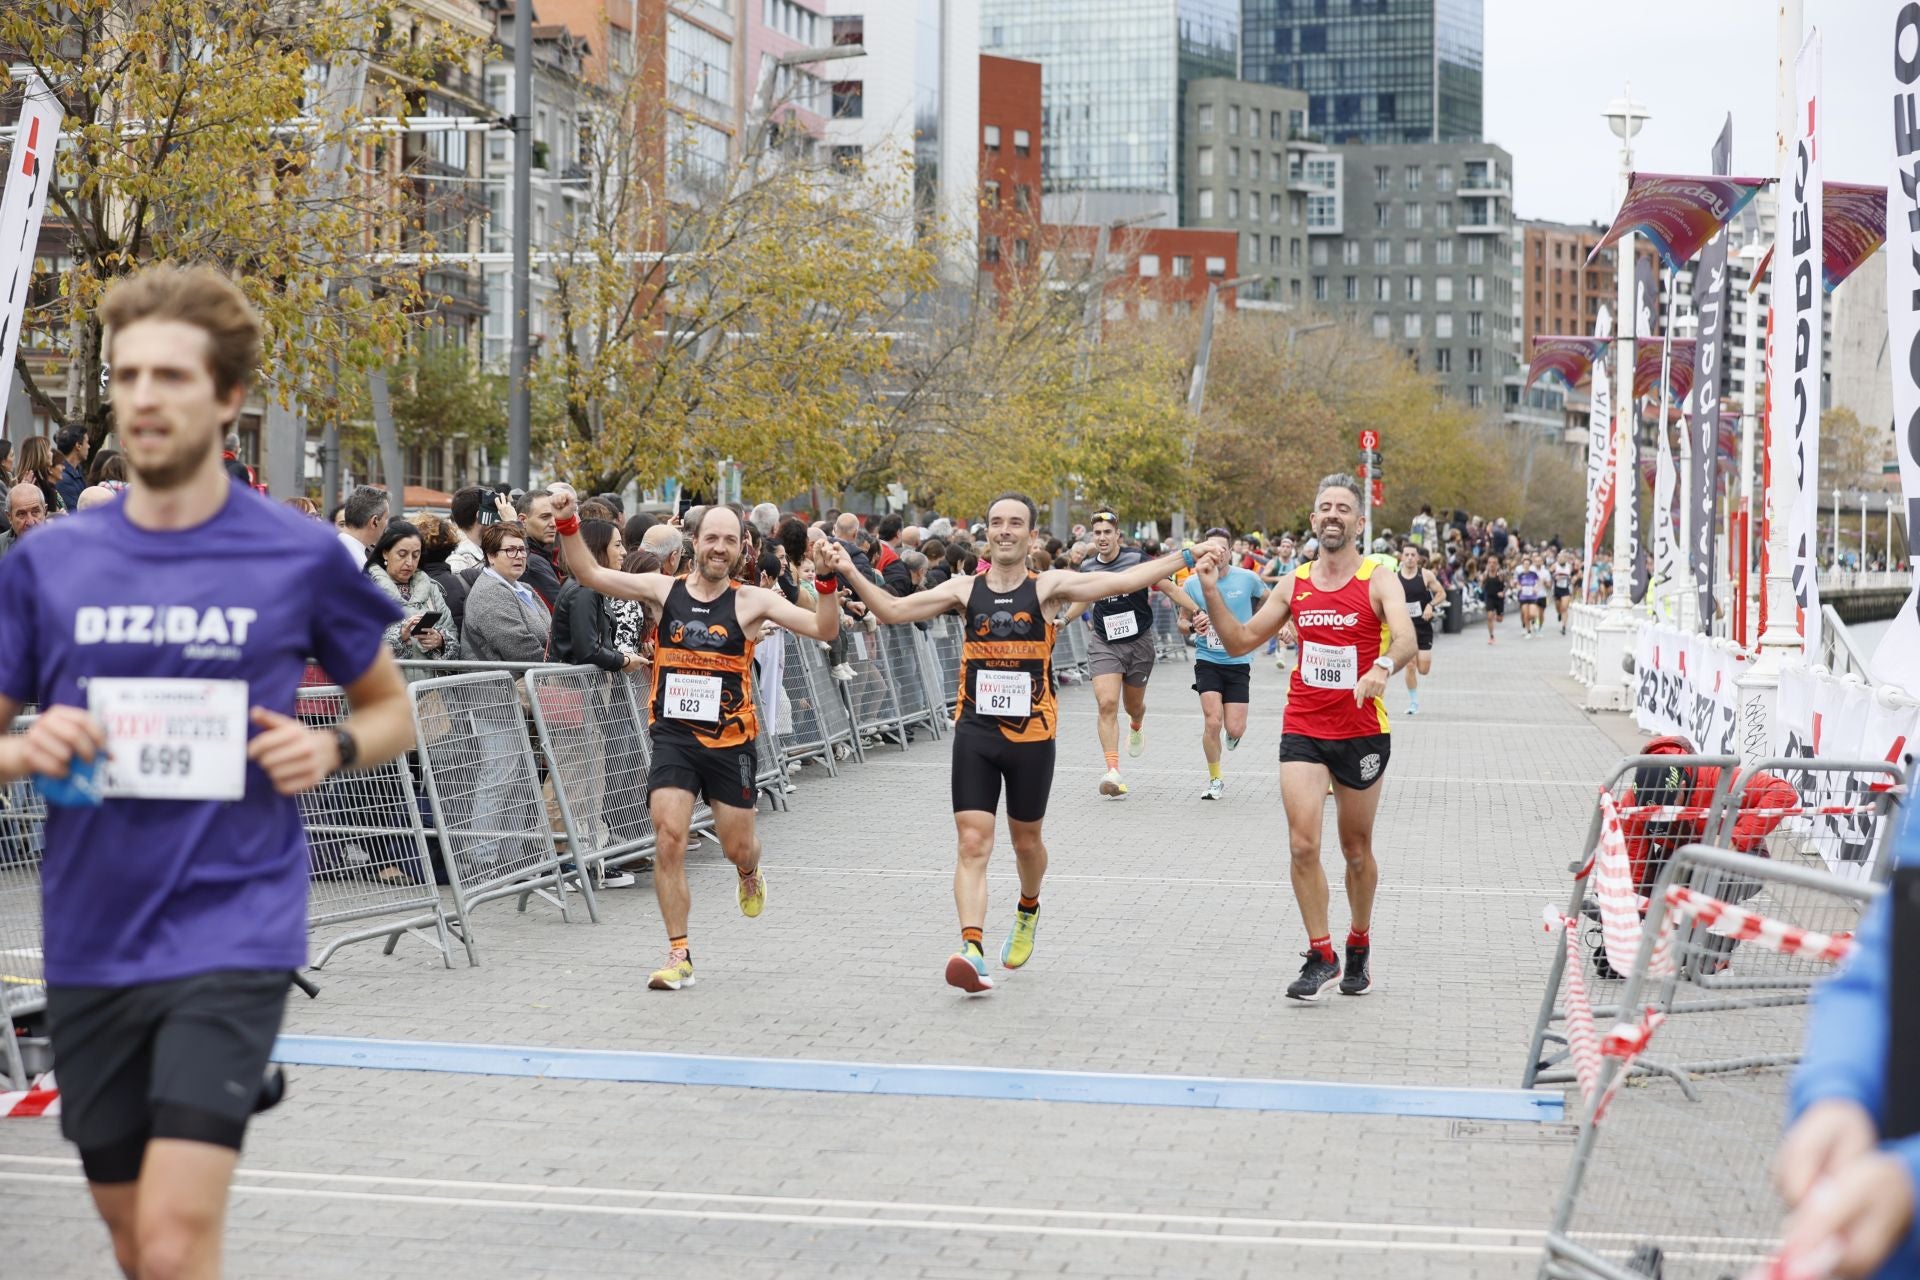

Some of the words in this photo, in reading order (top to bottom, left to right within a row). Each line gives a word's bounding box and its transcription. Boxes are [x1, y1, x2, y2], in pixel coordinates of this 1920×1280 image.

[1299, 615, 1344, 627] OZONO
[1114, 625, 1130, 635] 2273
[1306, 655, 1326, 667] XXXVI
[1315, 668, 1341, 683] 1898
[669, 686, 689, 697] XXXVI
[979, 682, 1001, 693] XXXVI
[679, 699, 700, 712] 623
[991, 695, 1011, 709] 621
[139, 744, 192, 775] 699
